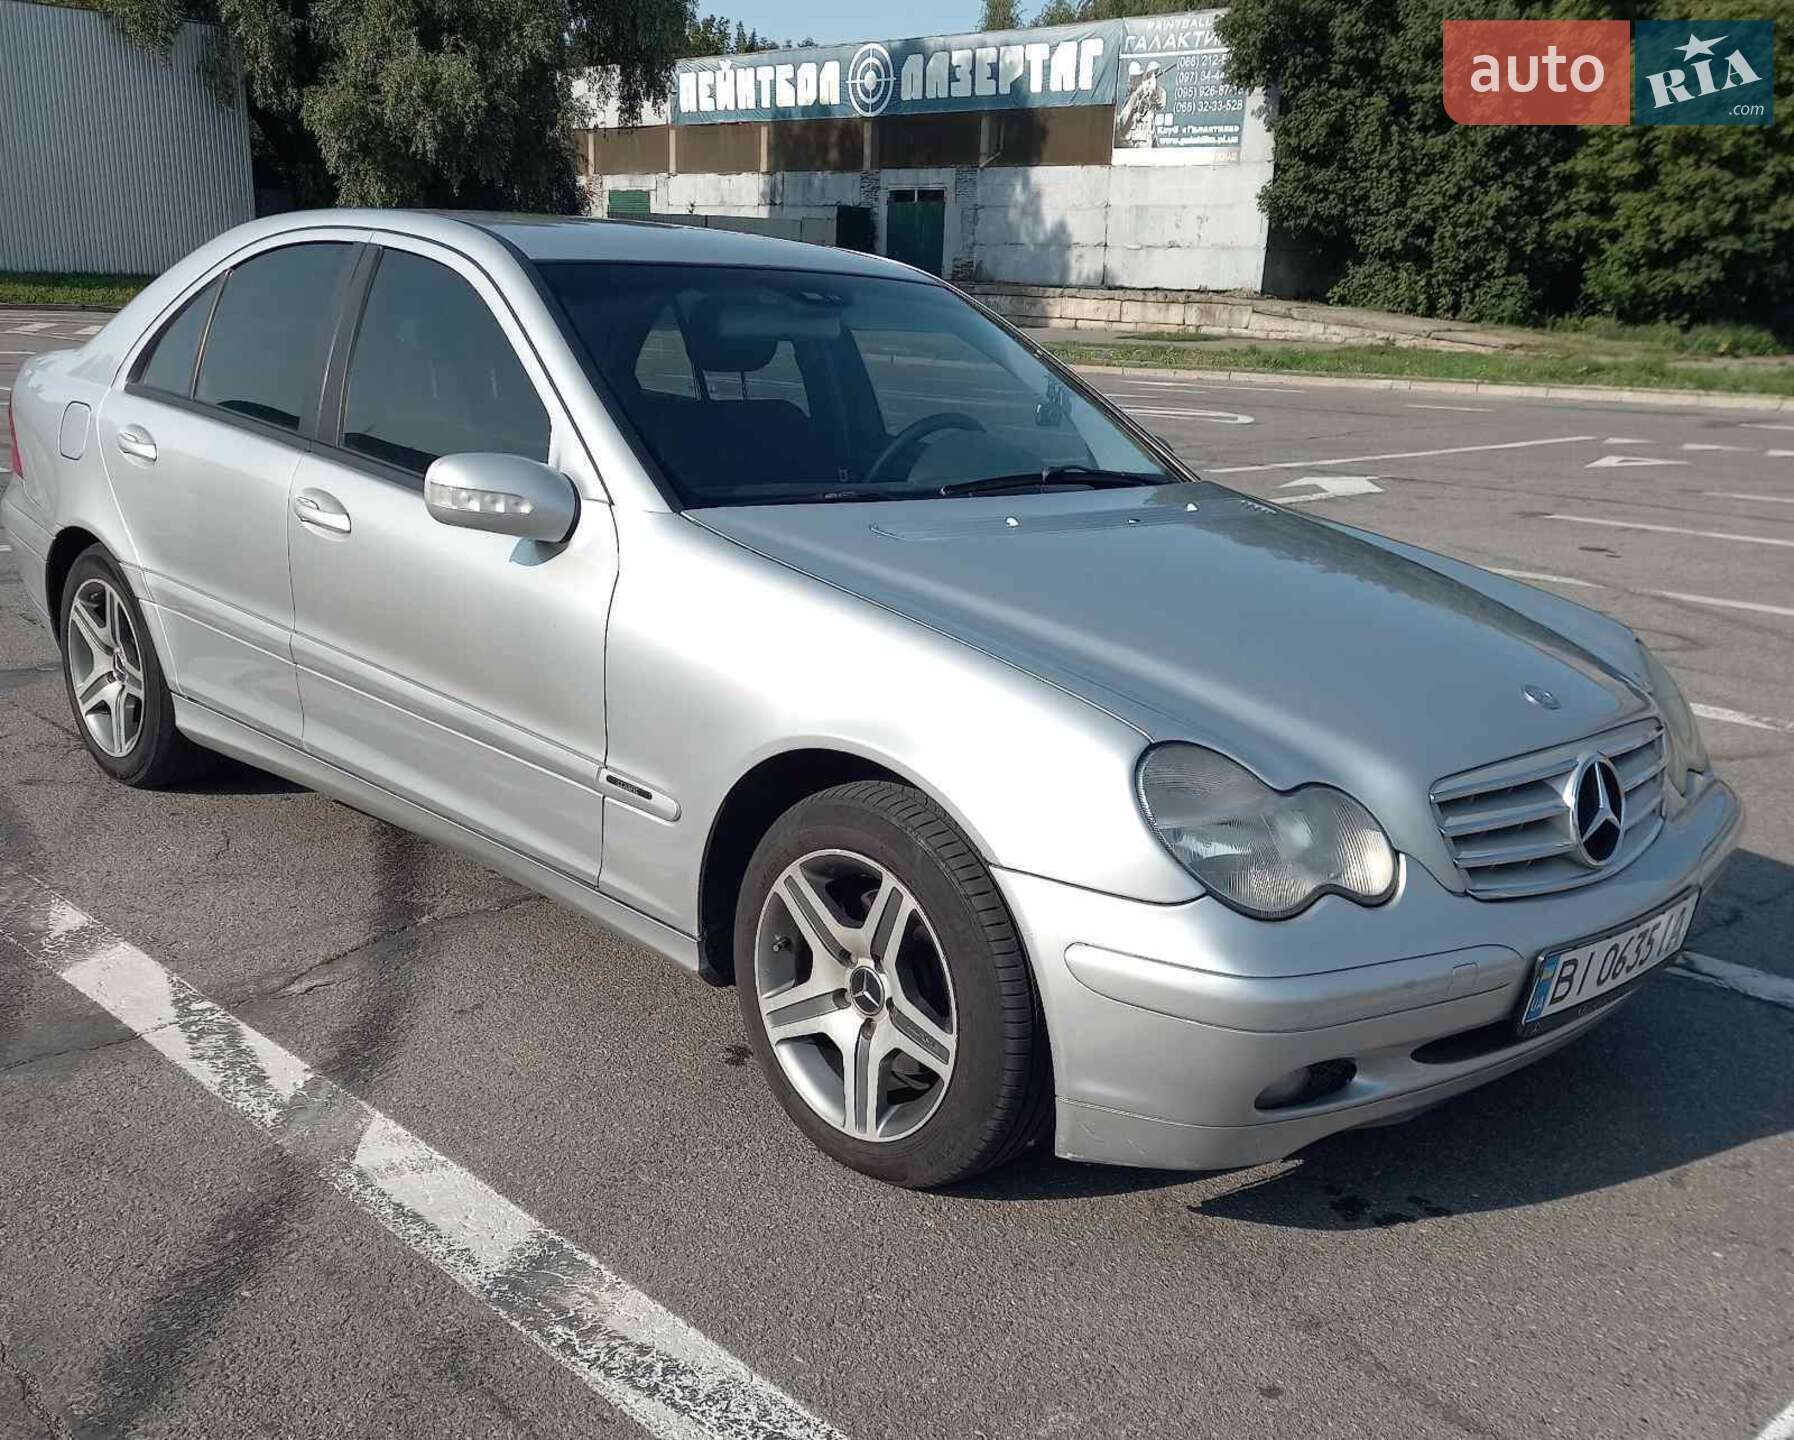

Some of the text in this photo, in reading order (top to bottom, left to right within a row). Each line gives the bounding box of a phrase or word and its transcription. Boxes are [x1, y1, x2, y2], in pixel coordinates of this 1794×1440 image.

[679, 38, 1104, 113] ПЕЙНТБОЛ ЛАЗЕРТАГ
[1175, 70, 1198, 85] (097)
[1549, 952, 1594, 1006] BI
